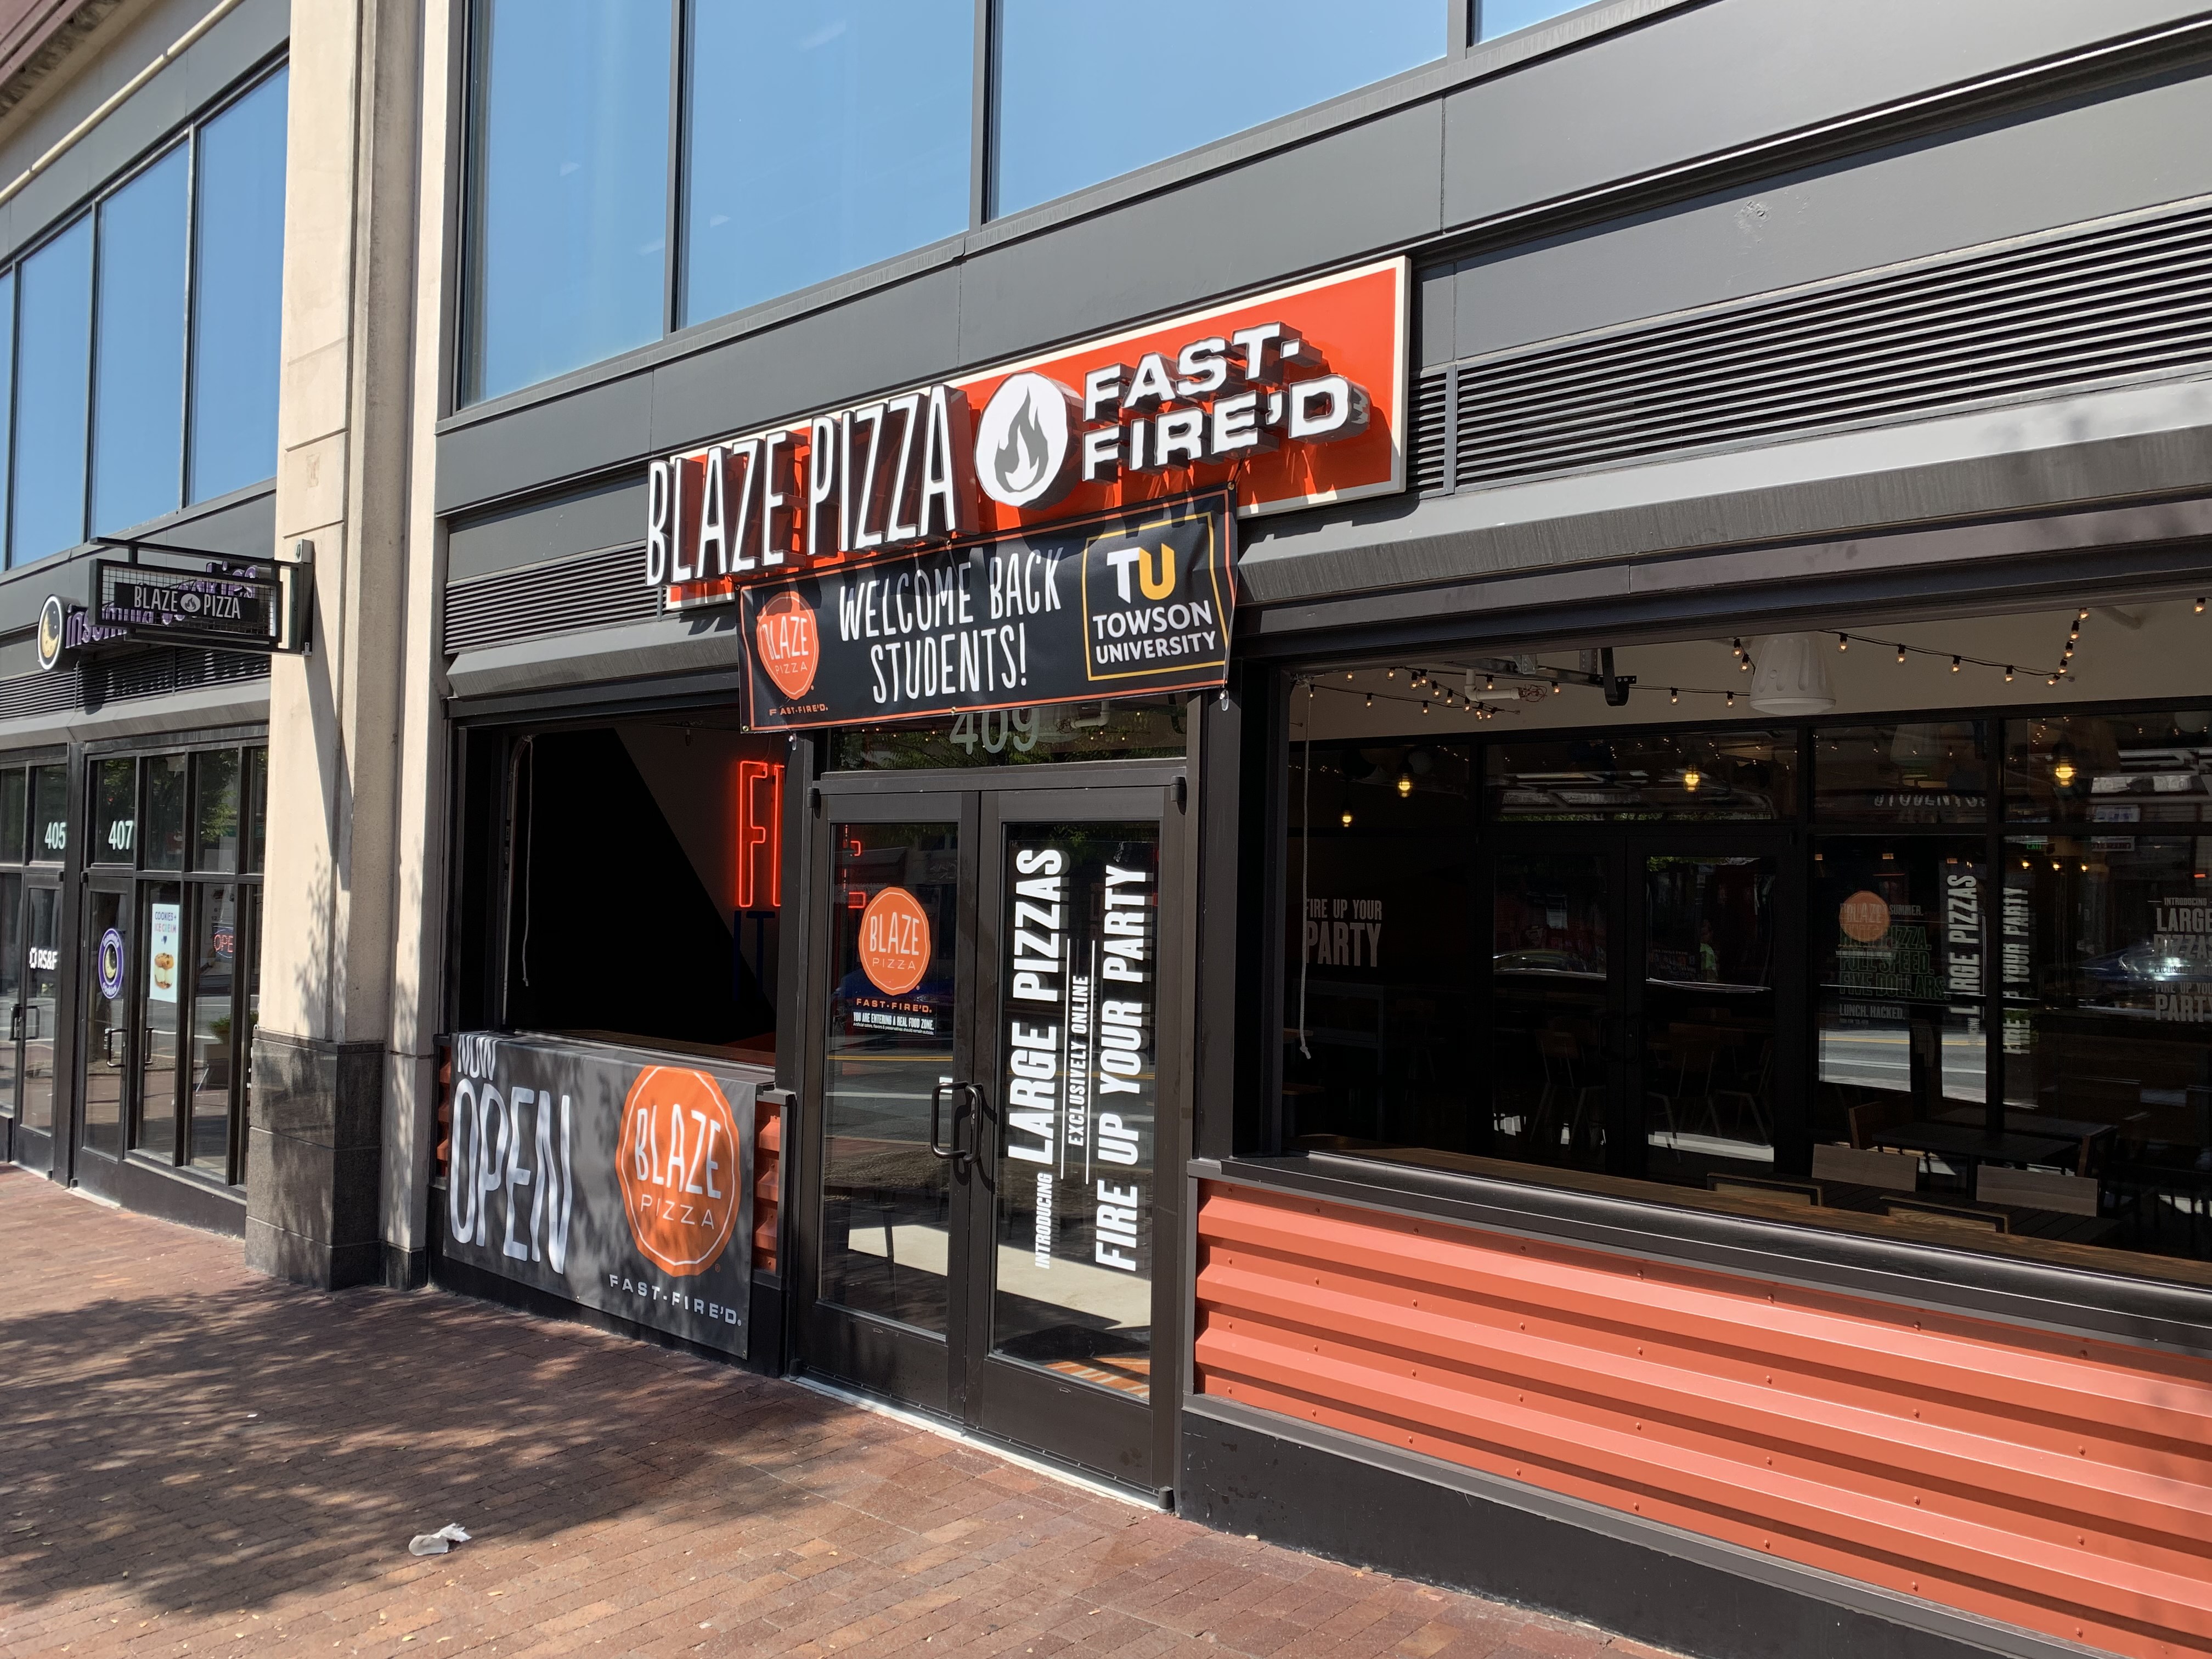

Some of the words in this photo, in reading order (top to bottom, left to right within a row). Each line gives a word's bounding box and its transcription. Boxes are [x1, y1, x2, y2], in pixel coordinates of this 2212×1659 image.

[1082, 375, 1350, 482] FIRE'D
[646, 430, 787, 586] BLAZE
[807, 383, 956, 556] PIZZA
[134, 585, 178, 612] BLAZE
[204, 594, 241, 619] PIZZA
[839, 562, 974, 641] WELCOME
[989, 546, 1064, 619] BACK
[1107, 543, 1176, 604] TU
[1092, 600, 1212, 640] TOWSON
[1096, 631, 1216, 664] UNIVERSITY
[775, 662, 808, 675] PIZZA
[871, 622, 1026, 703] STUDENTS!
[949, 708, 1041, 755] 409
[44, 822, 66, 849] 405
[109, 820, 133, 850] 407
[870, 911, 920, 956] BLAZE
[1013, 849, 1062, 1002] PIZZAS
[1103, 865, 1146, 983] PARTY
[1333, 899, 1348, 919] UP
[1352, 899, 1383, 920] YOUR
[1946, 874, 1979, 945] PIZZAS
[214, 934, 234, 953] OPE
[872, 957, 917, 970] PIZZA
[1306, 921, 1381, 967] PARTY
[1071, 975, 1088, 1034] ONLINE
[1948, 952, 1981, 1016] LRGE
[853, 1012, 861, 1022] YOU
[862, 1013, 870, 1023] ARE
[871, 1014, 892, 1025] ENTERING
[893, 1016, 896, 1026] A
[897, 1017, 907, 1027] REAL
[909, 1018, 920, 1029] FOOD
[921, 1019, 934, 1030] ZONE.
[1099, 1000, 1142, 1094] YOUR
[458, 1034, 502, 1080] NOW
[1008, 1022, 1057, 1165] LARGE
[1068, 1040, 1087, 1147] EXCLUSIVELY
[635, 1103, 721, 1199] BLAZE
[1098, 1113, 1139, 1165] UP
[450, 1079, 572, 1275] OPEN
[640, 1194, 714, 1230] PIZZA
[1035, 1173, 1053, 1269] INTRODUCING
[1095, 1180, 1138, 1272] FIRE
